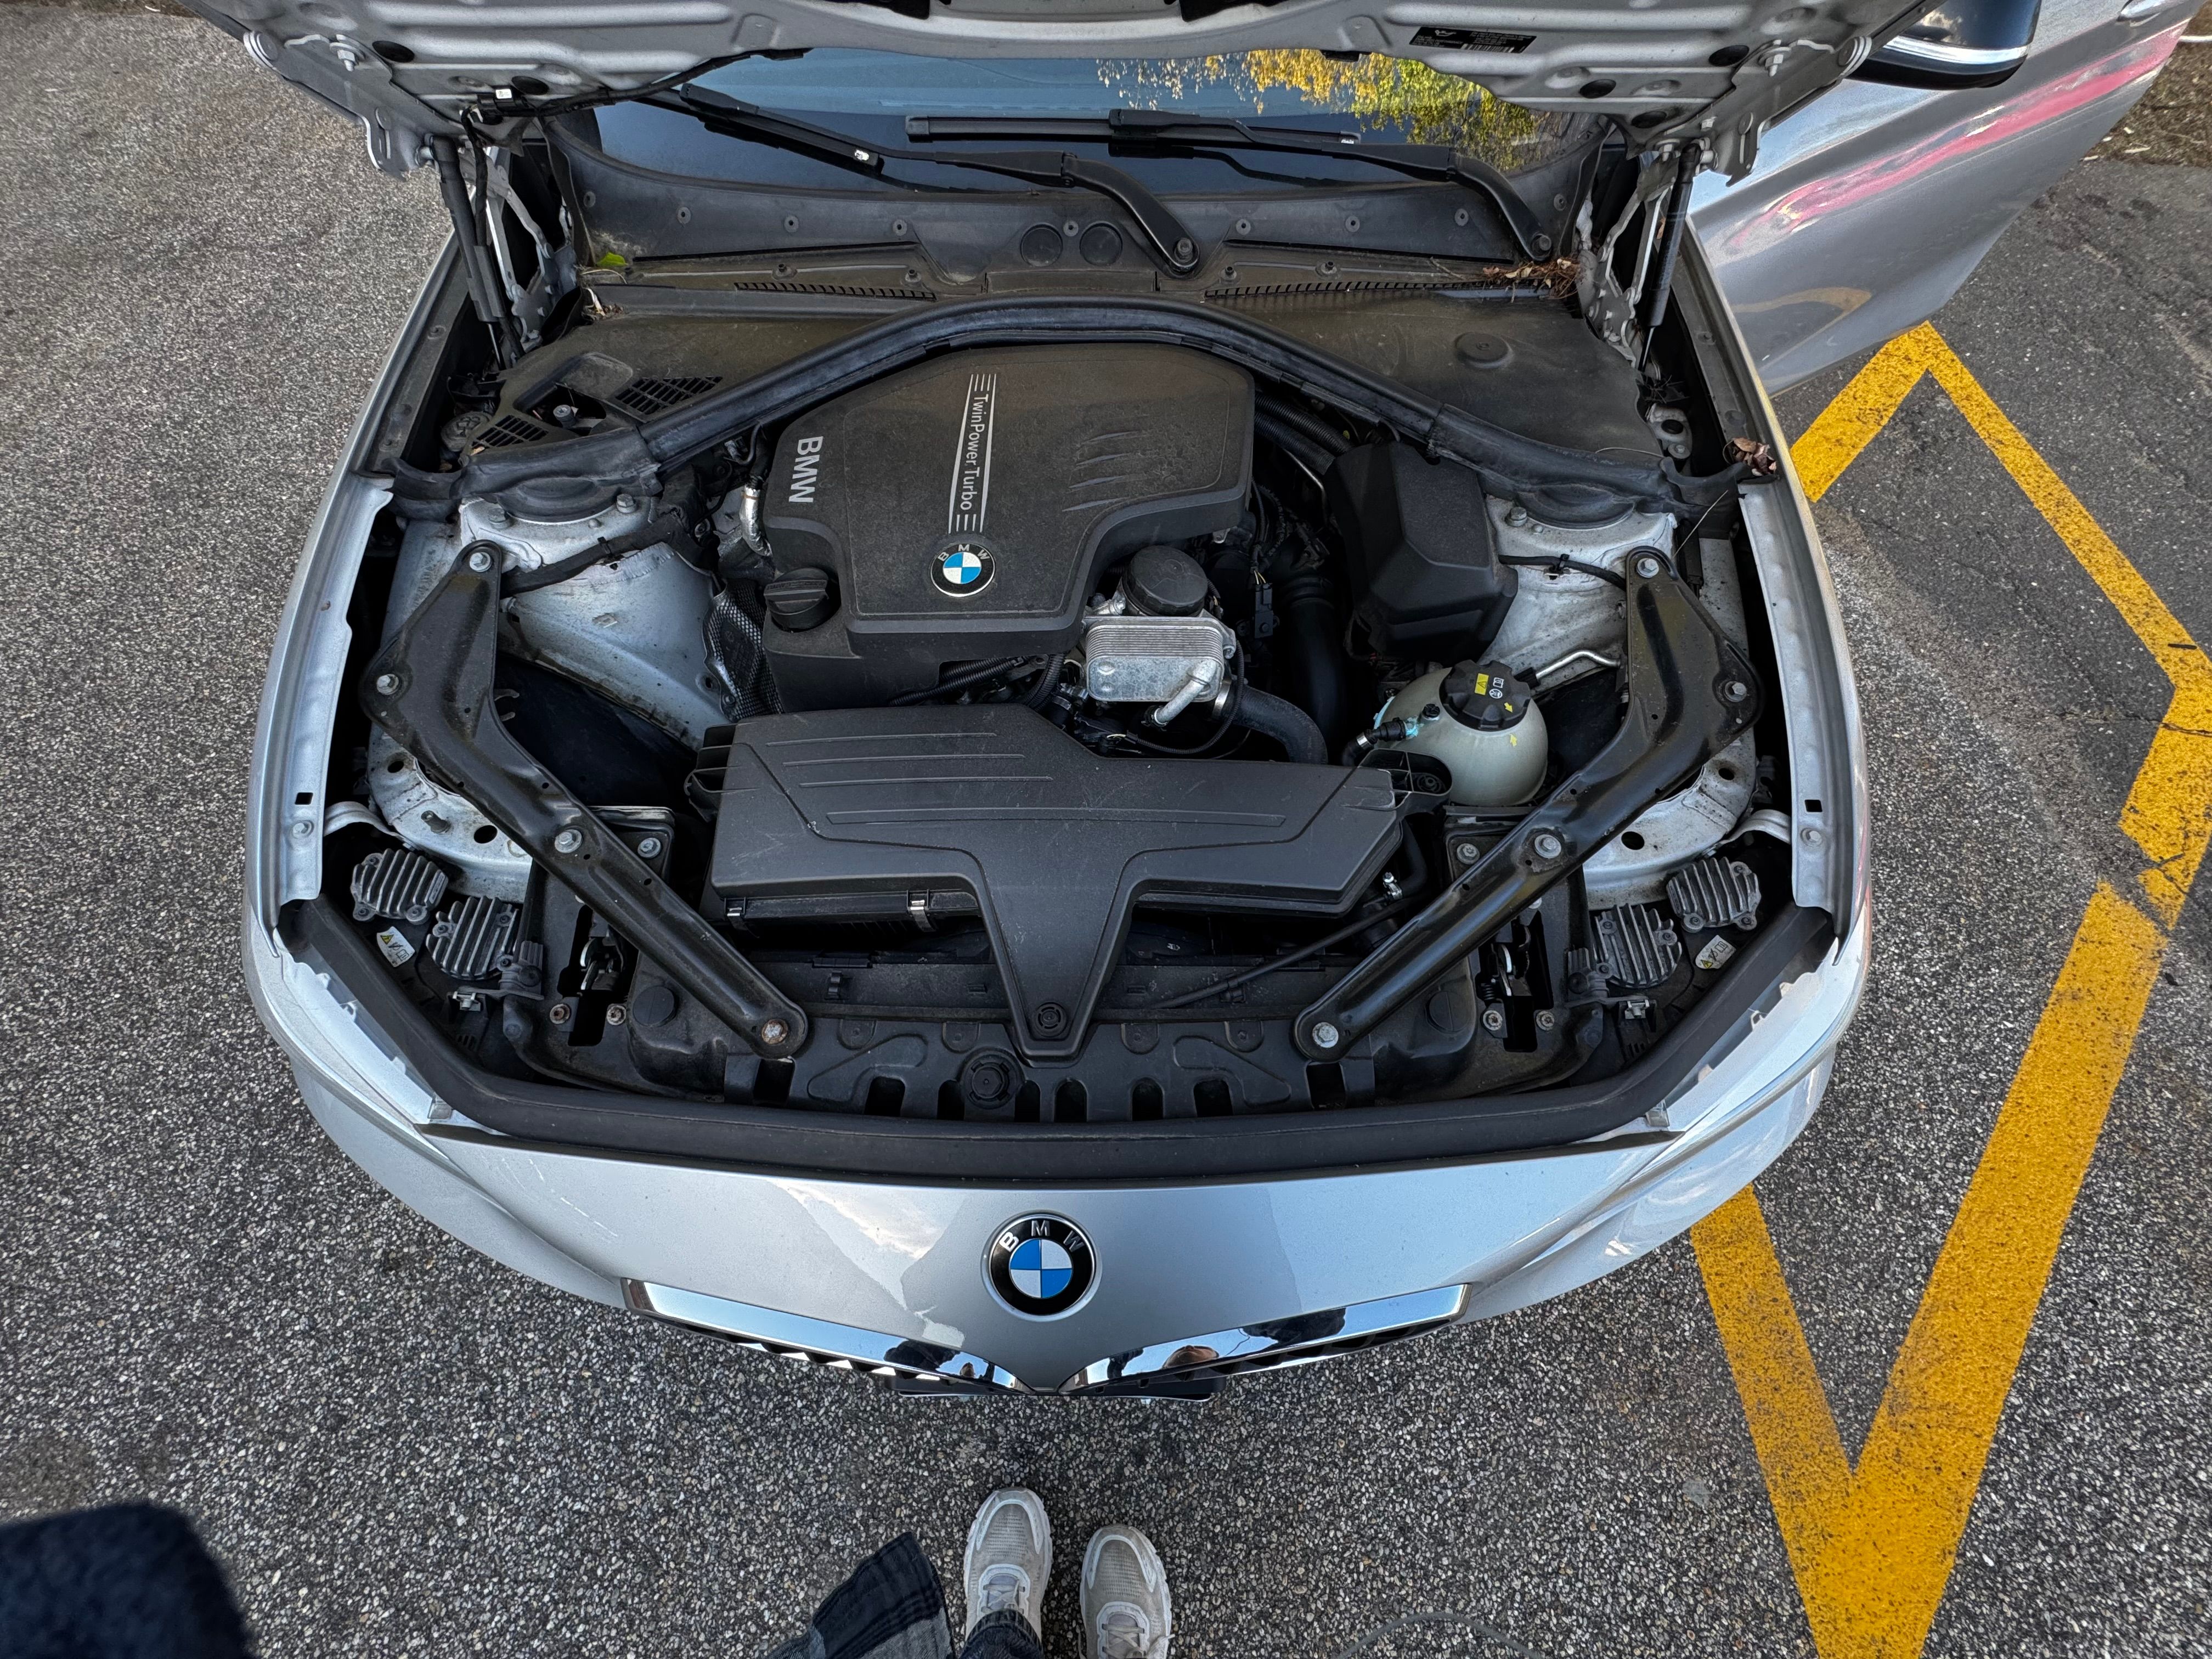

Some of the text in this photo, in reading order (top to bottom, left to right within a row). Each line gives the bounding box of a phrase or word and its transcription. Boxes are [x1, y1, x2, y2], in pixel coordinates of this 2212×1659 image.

[789, 436, 823, 503] BMW
[937, 544, 990, 562] BMW
[999, 1220, 1085, 1252] BMW
